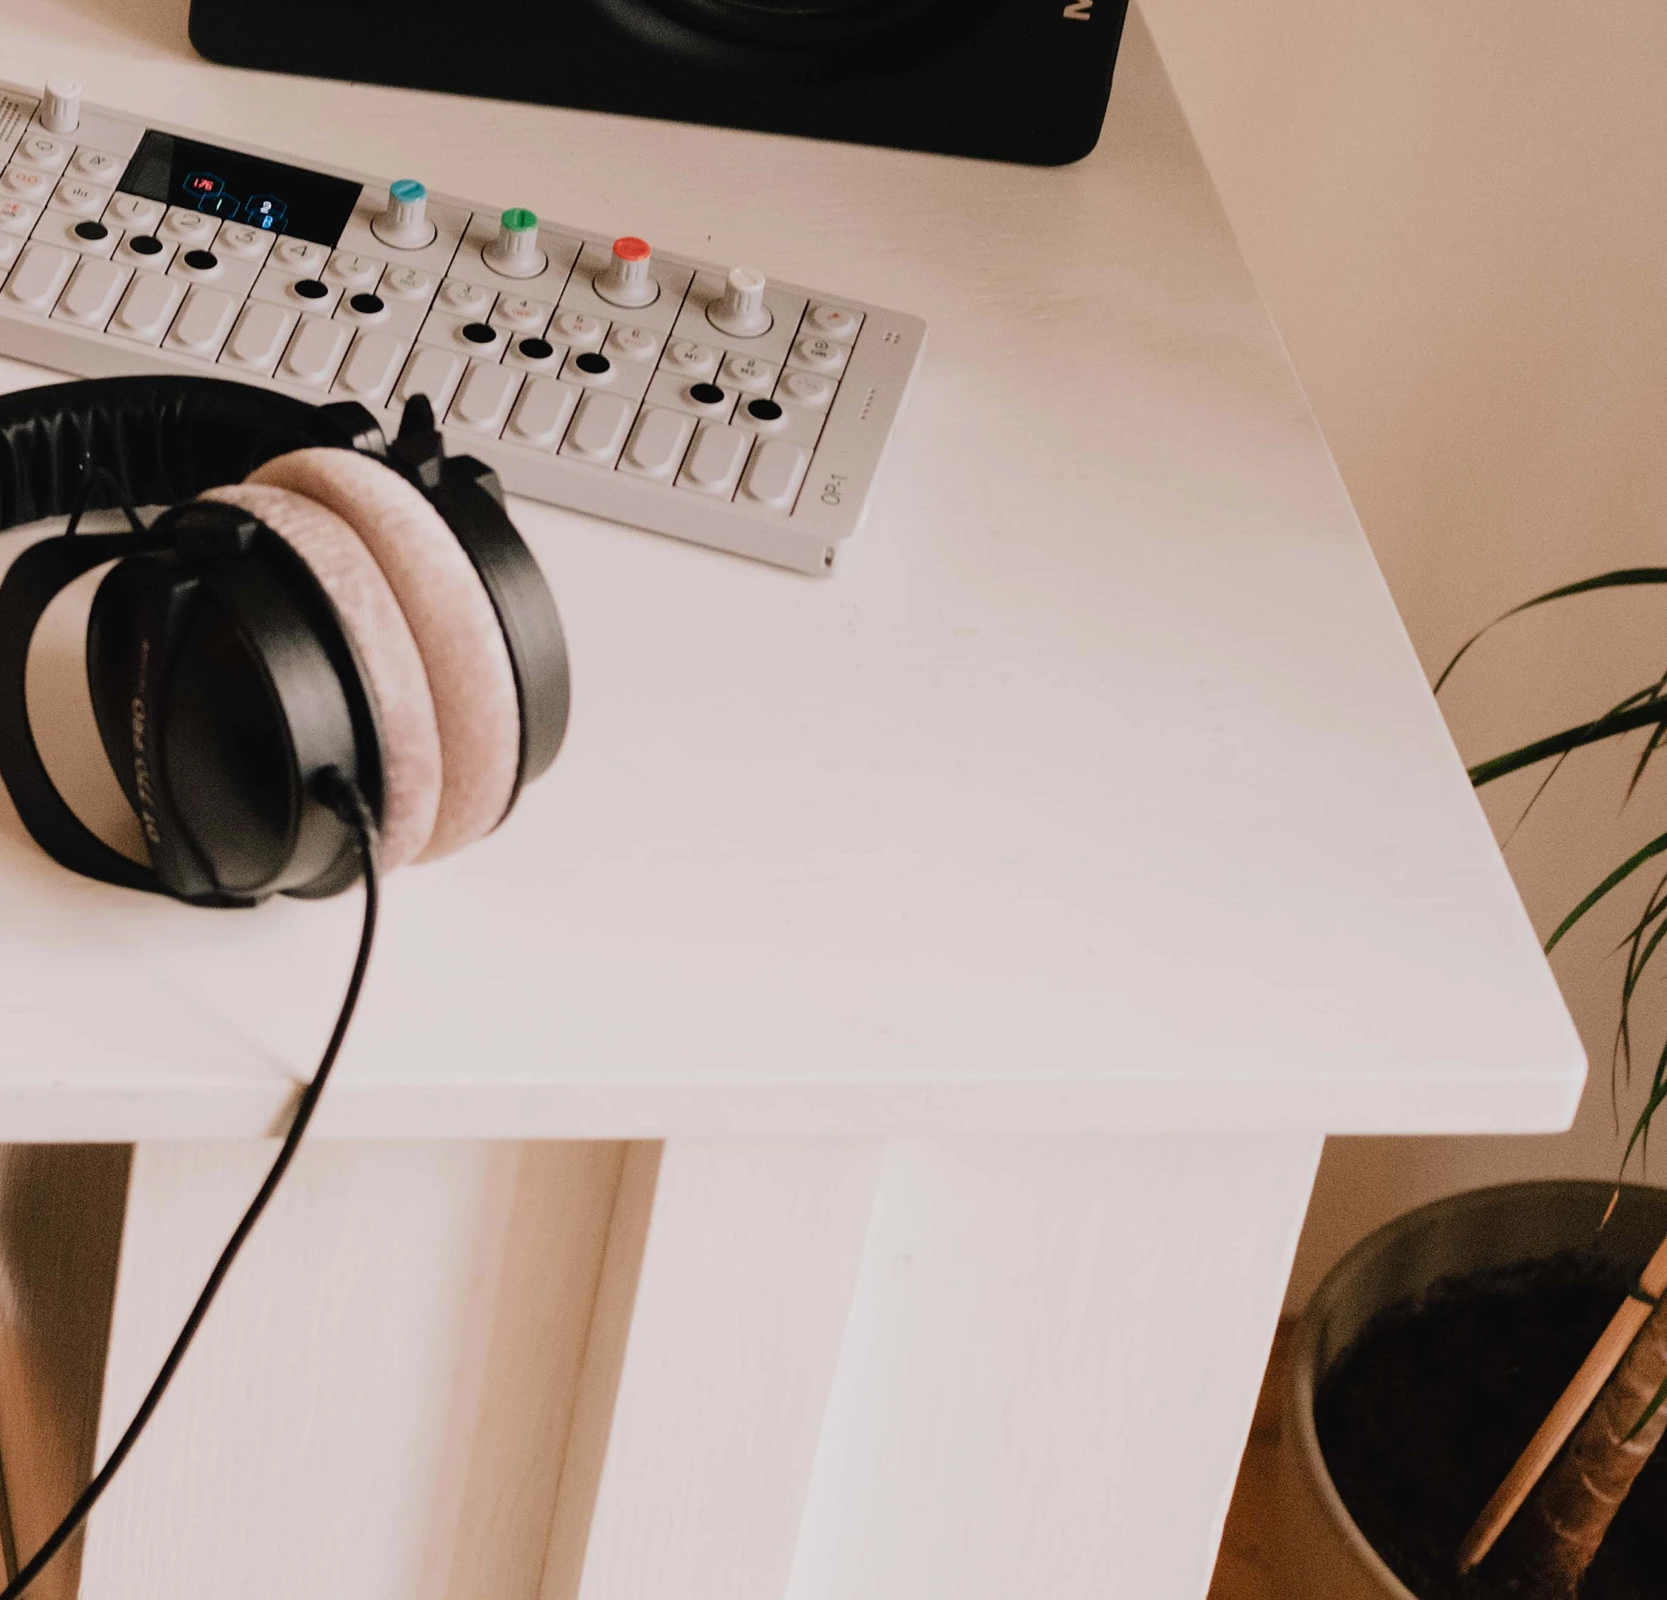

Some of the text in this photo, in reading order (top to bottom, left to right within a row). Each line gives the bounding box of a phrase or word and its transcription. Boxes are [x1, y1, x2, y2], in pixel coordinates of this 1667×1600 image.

[260, 200, 272, 214] 2
[180, 214, 201, 227] 2
[235, 225, 256, 244] 3
[290, 245, 308, 257] 4
[821, 473, 848, 505] OP-1
